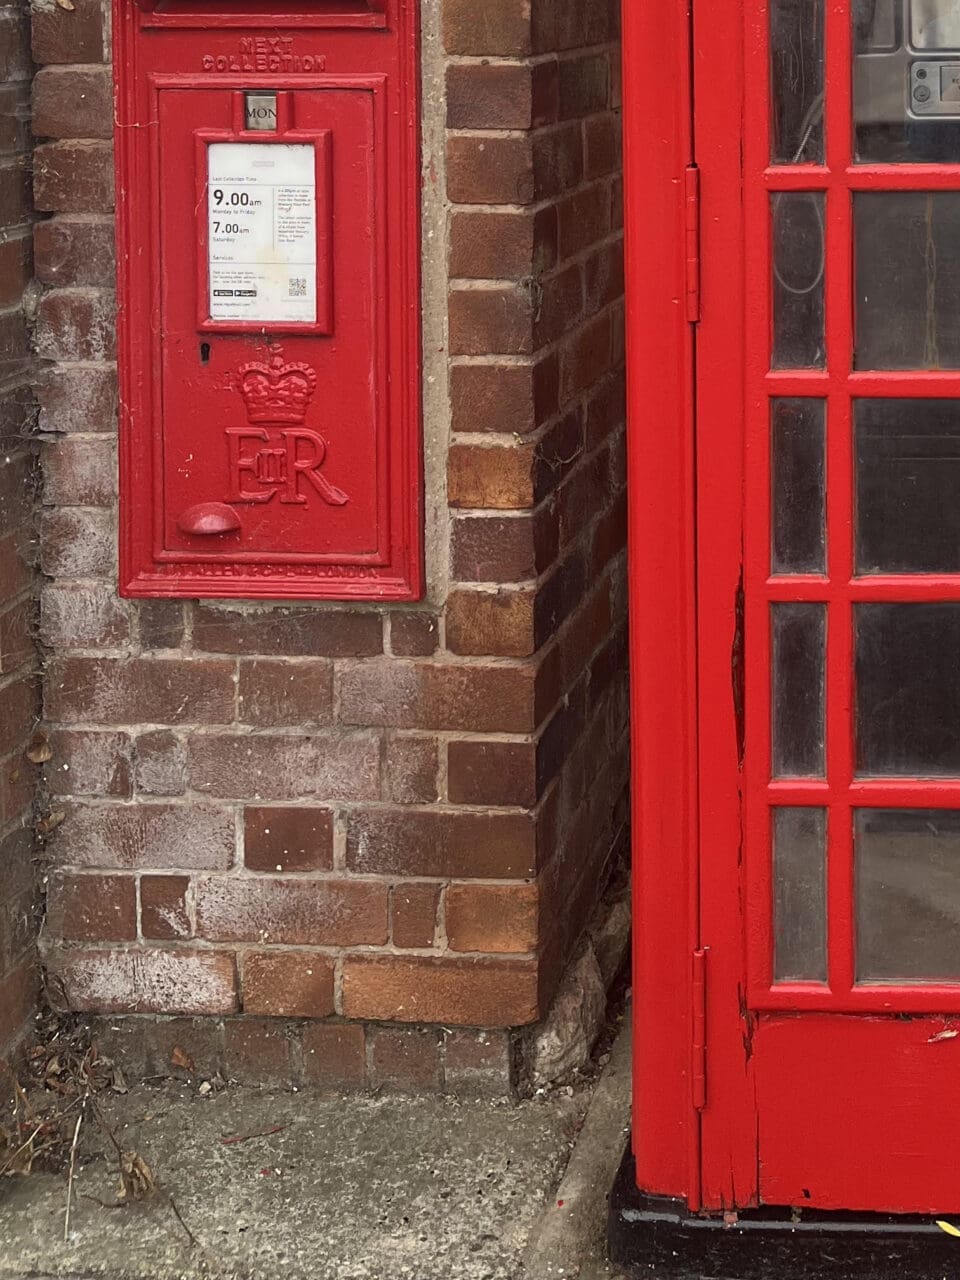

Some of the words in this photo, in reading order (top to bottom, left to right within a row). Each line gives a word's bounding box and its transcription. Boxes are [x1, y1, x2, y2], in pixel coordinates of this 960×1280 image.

[240, 37, 294, 55] NEXT
[202, 54, 327, 72] COLLECTION
[246, 107, 277, 119] MON
[213, 189, 262, 206] 9.00am
[213, 221, 250, 234] 7.00am
[317, 565, 378, 579] LONDON
